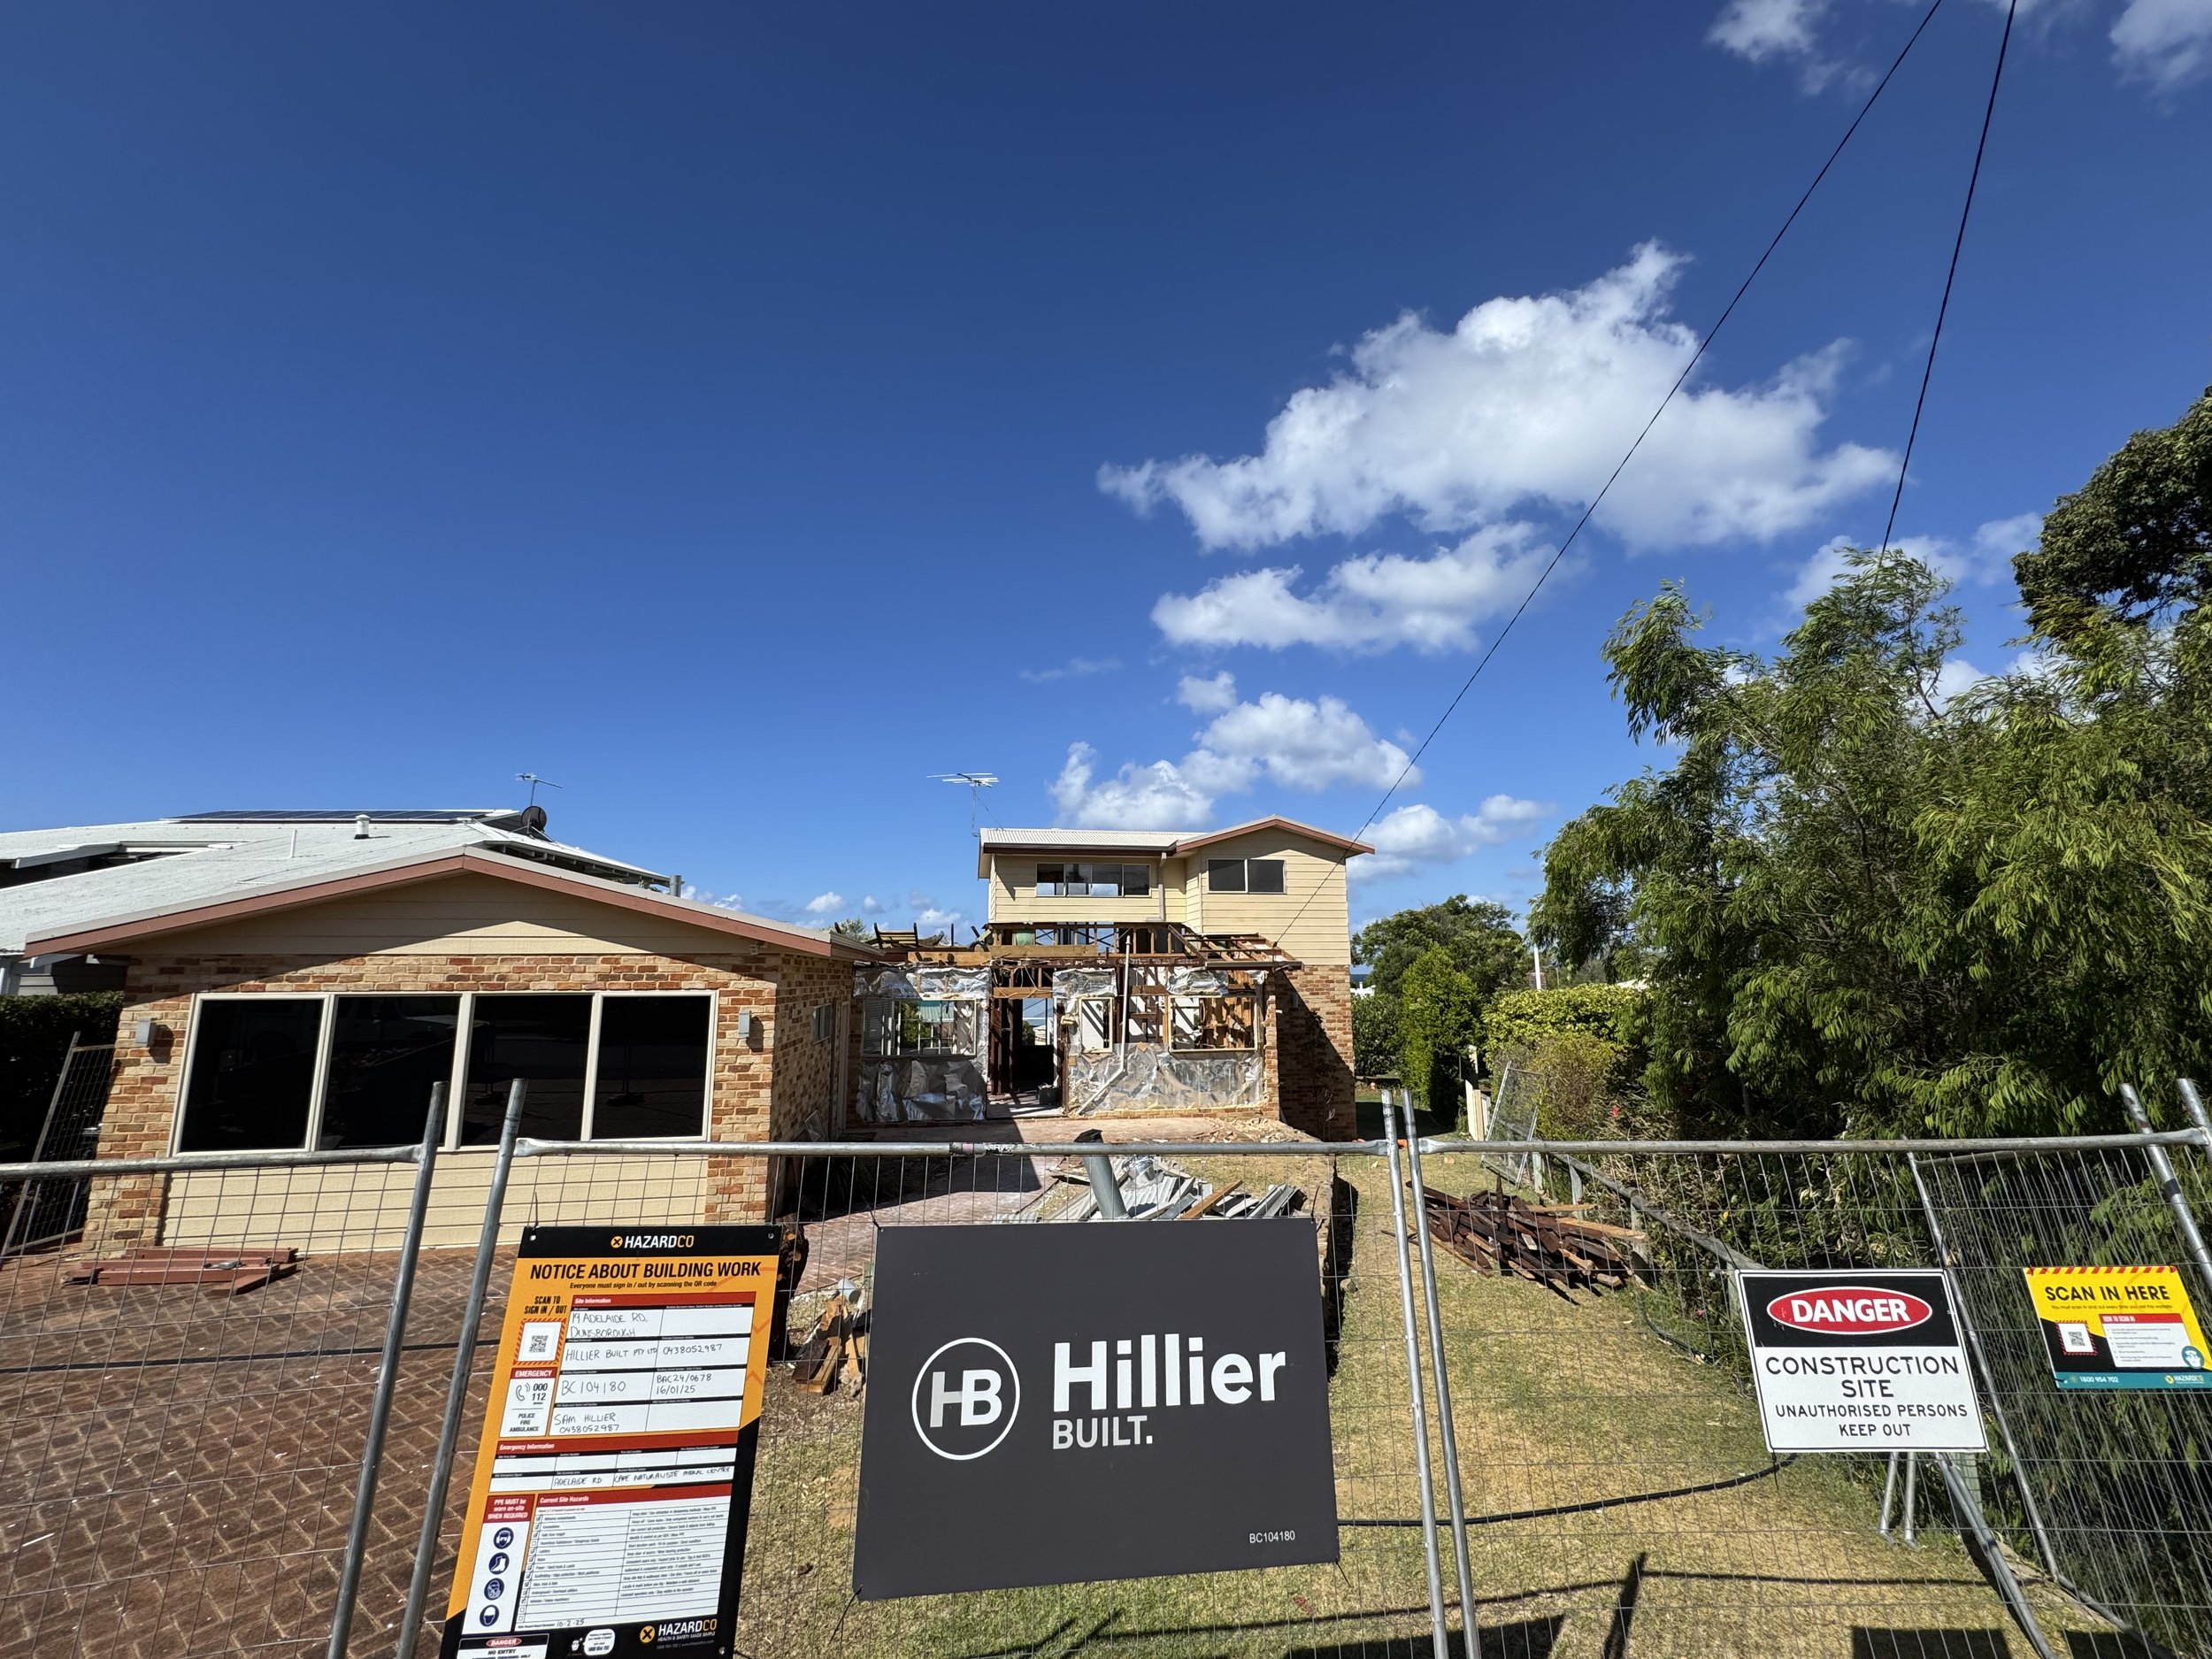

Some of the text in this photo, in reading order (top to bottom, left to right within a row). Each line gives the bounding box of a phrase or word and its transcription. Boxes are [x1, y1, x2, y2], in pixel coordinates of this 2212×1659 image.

[624, 1235, 695, 1248] HAZARDCO
[530, 1262, 762, 1279] NOTICE ABOUT BUILDING WORK
[554, 1295, 561, 1304] TO
[2045, 1285, 2170, 1302] SCAN IN HERE
[1791, 1298, 1911, 1323] DANGER
[572, 1312, 580, 1324] 19
[583, 1312, 626, 1324] ADELAIDE
[570, 1325, 635, 1338] DUNSBOROUGH
[565, 1349, 600, 1361] HILLIER
[606, 1349, 629, 1359] BUILT
[663, 1343, 723, 1356] 0438052987
[1765, 1356, 1960, 1375] CONSTRUCTION
[1053, 1333, 1286, 1413] Hillier
[534, 1383, 548, 1392] 000
[657, 1385, 696, 1395] 16/01/25
[1841, 1379, 1894, 1398] SITE
[929, 1369, 1002, 1428] HB
[1776, 1403, 1968, 1417] UNAUTHORISED PERSONS
[554, 1412, 616, 1425] SAM HILLIER
[559, 1424, 619, 1434] 0438052987
[1052, 1416, 1153, 1450] BUILT.
[1839, 1424, 1910, 1437] KEEP OUT
[554, 1477, 588, 1486] ADELAIDE
[1248, 1530, 1296, 1545] BC104180
[658, 1618, 718, 1636] HAZARDCO
